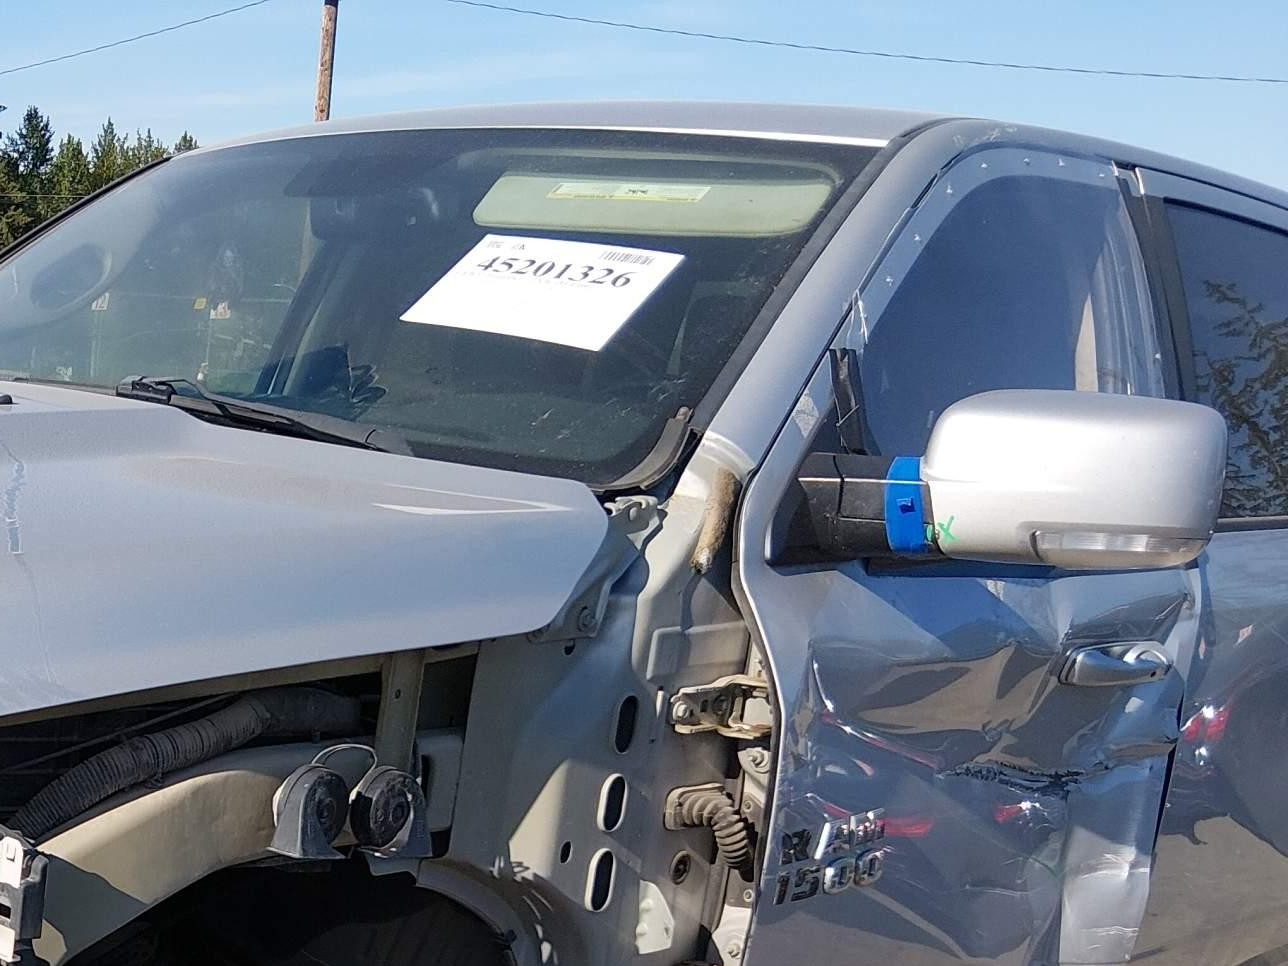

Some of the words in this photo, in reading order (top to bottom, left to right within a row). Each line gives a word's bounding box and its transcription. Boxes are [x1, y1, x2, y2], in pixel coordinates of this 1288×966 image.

[477, 255, 635, 288] 45201326
[779, 808, 885, 865] RAM
[773, 846, 892, 905] 1500
